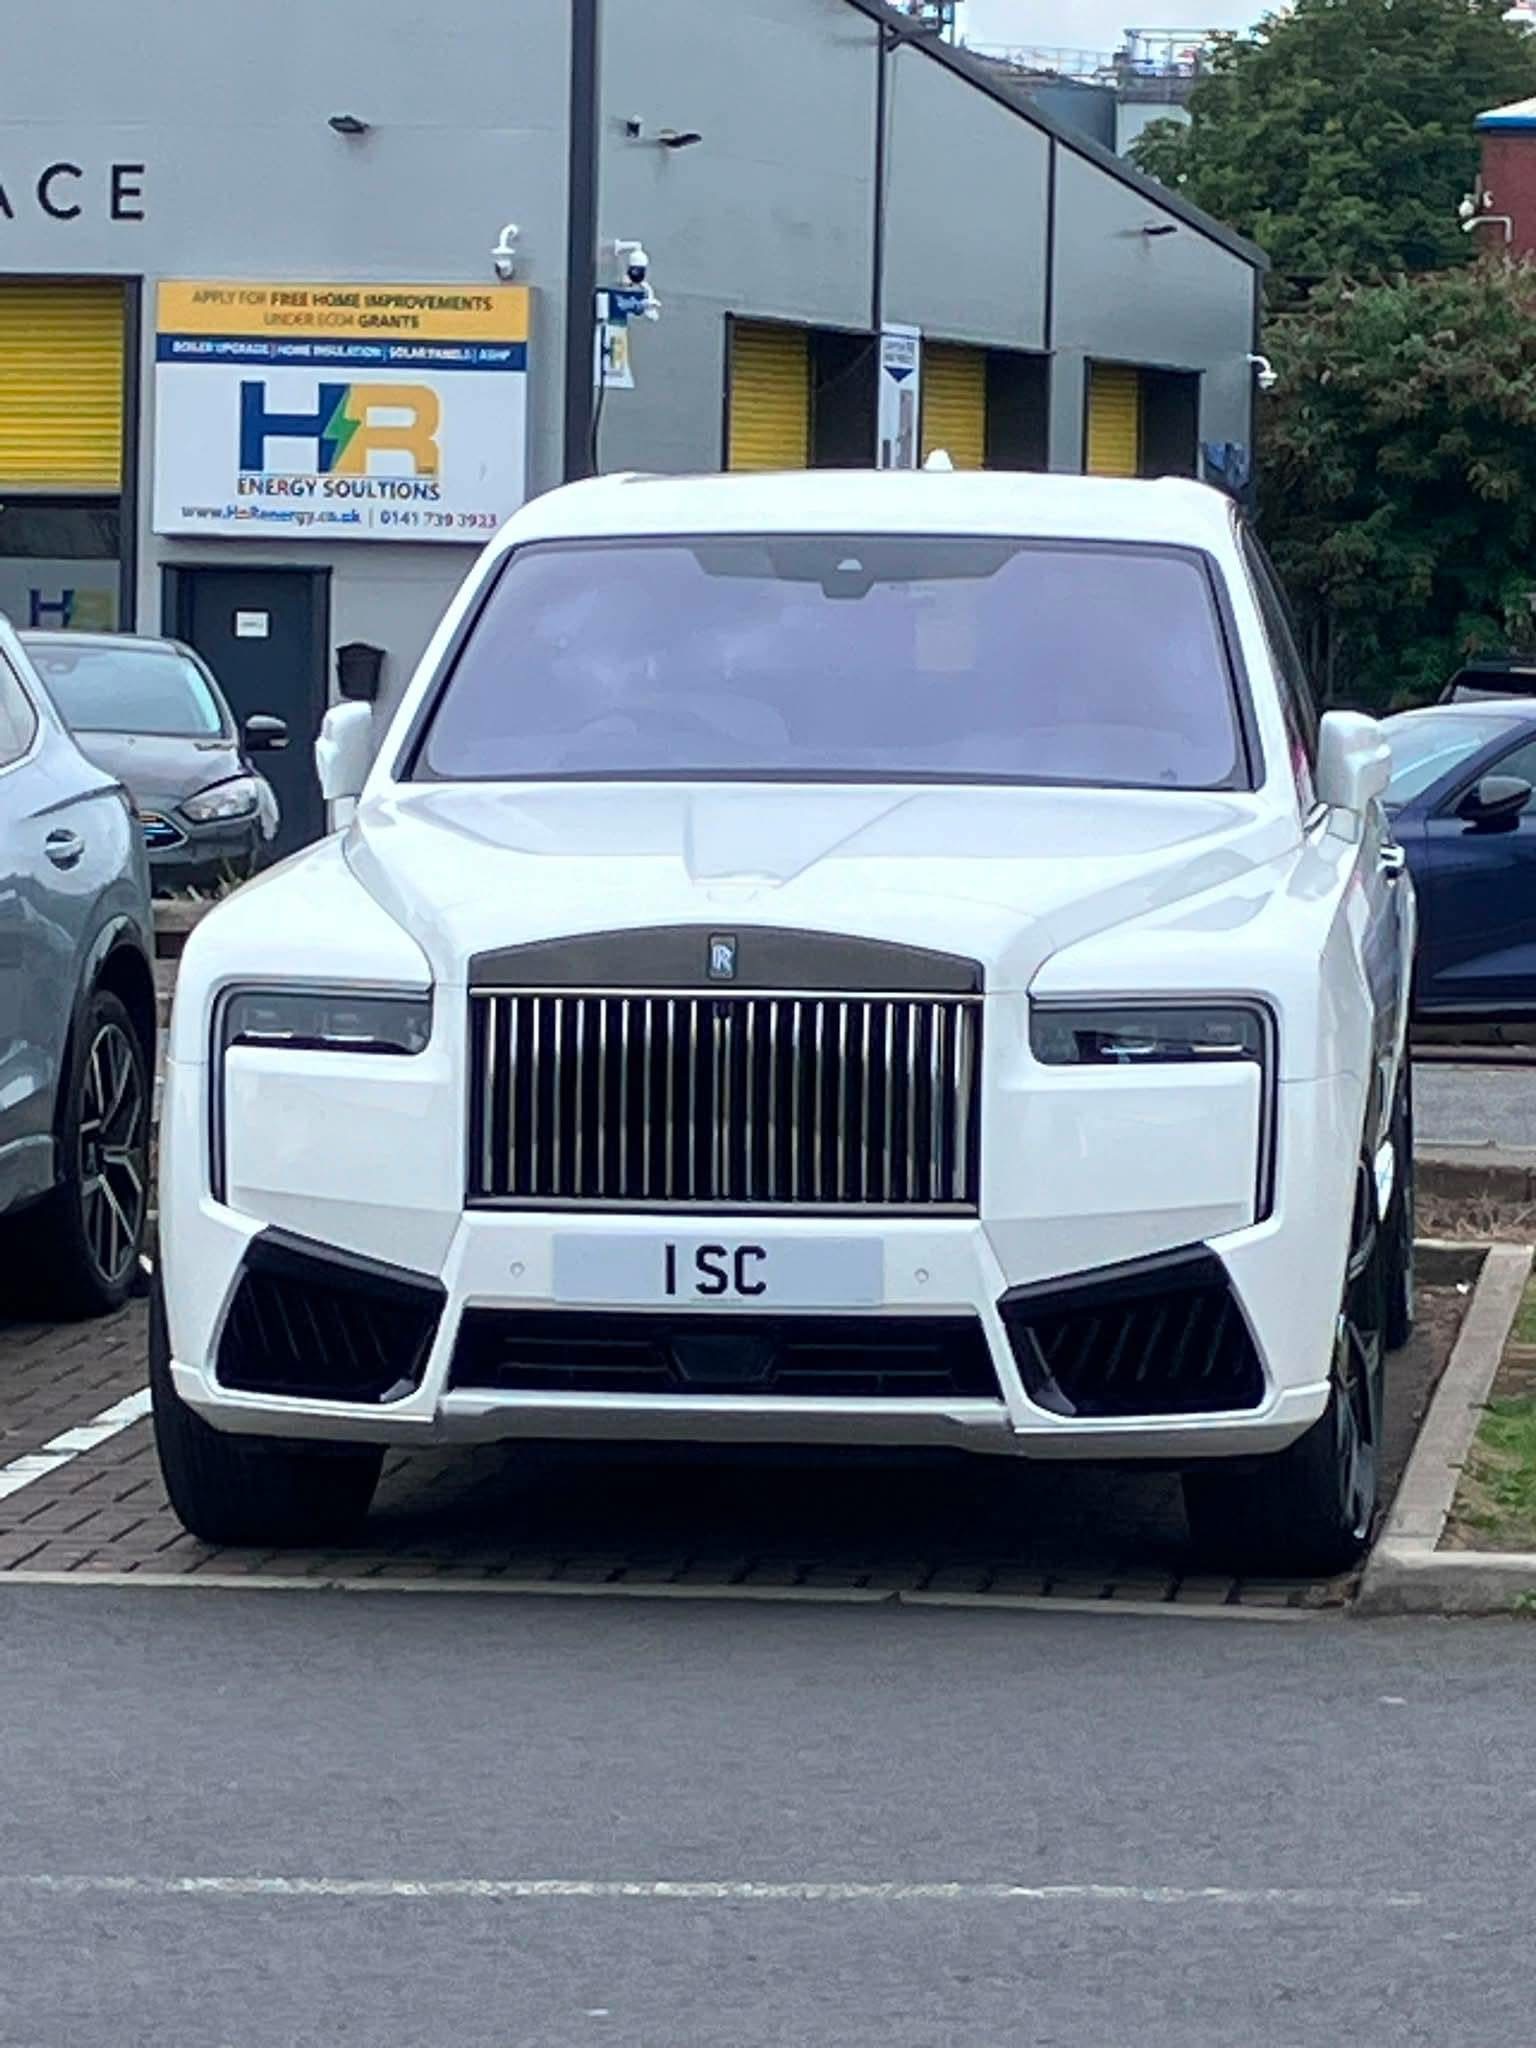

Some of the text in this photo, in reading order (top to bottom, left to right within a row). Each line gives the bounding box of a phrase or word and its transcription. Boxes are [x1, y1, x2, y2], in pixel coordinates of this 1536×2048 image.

[191, 291, 493, 311] APPLY FOR FREE HOME IMPROVEMENTS
[264, 312, 314, 325] UNDER
[358, 315, 419, 328] GRANTS
[237, 478, 440, 500] ENERGY SOULTIONS
[380, 509, 419, 525] 0141
[695, 1245, 767, 1295] SC
